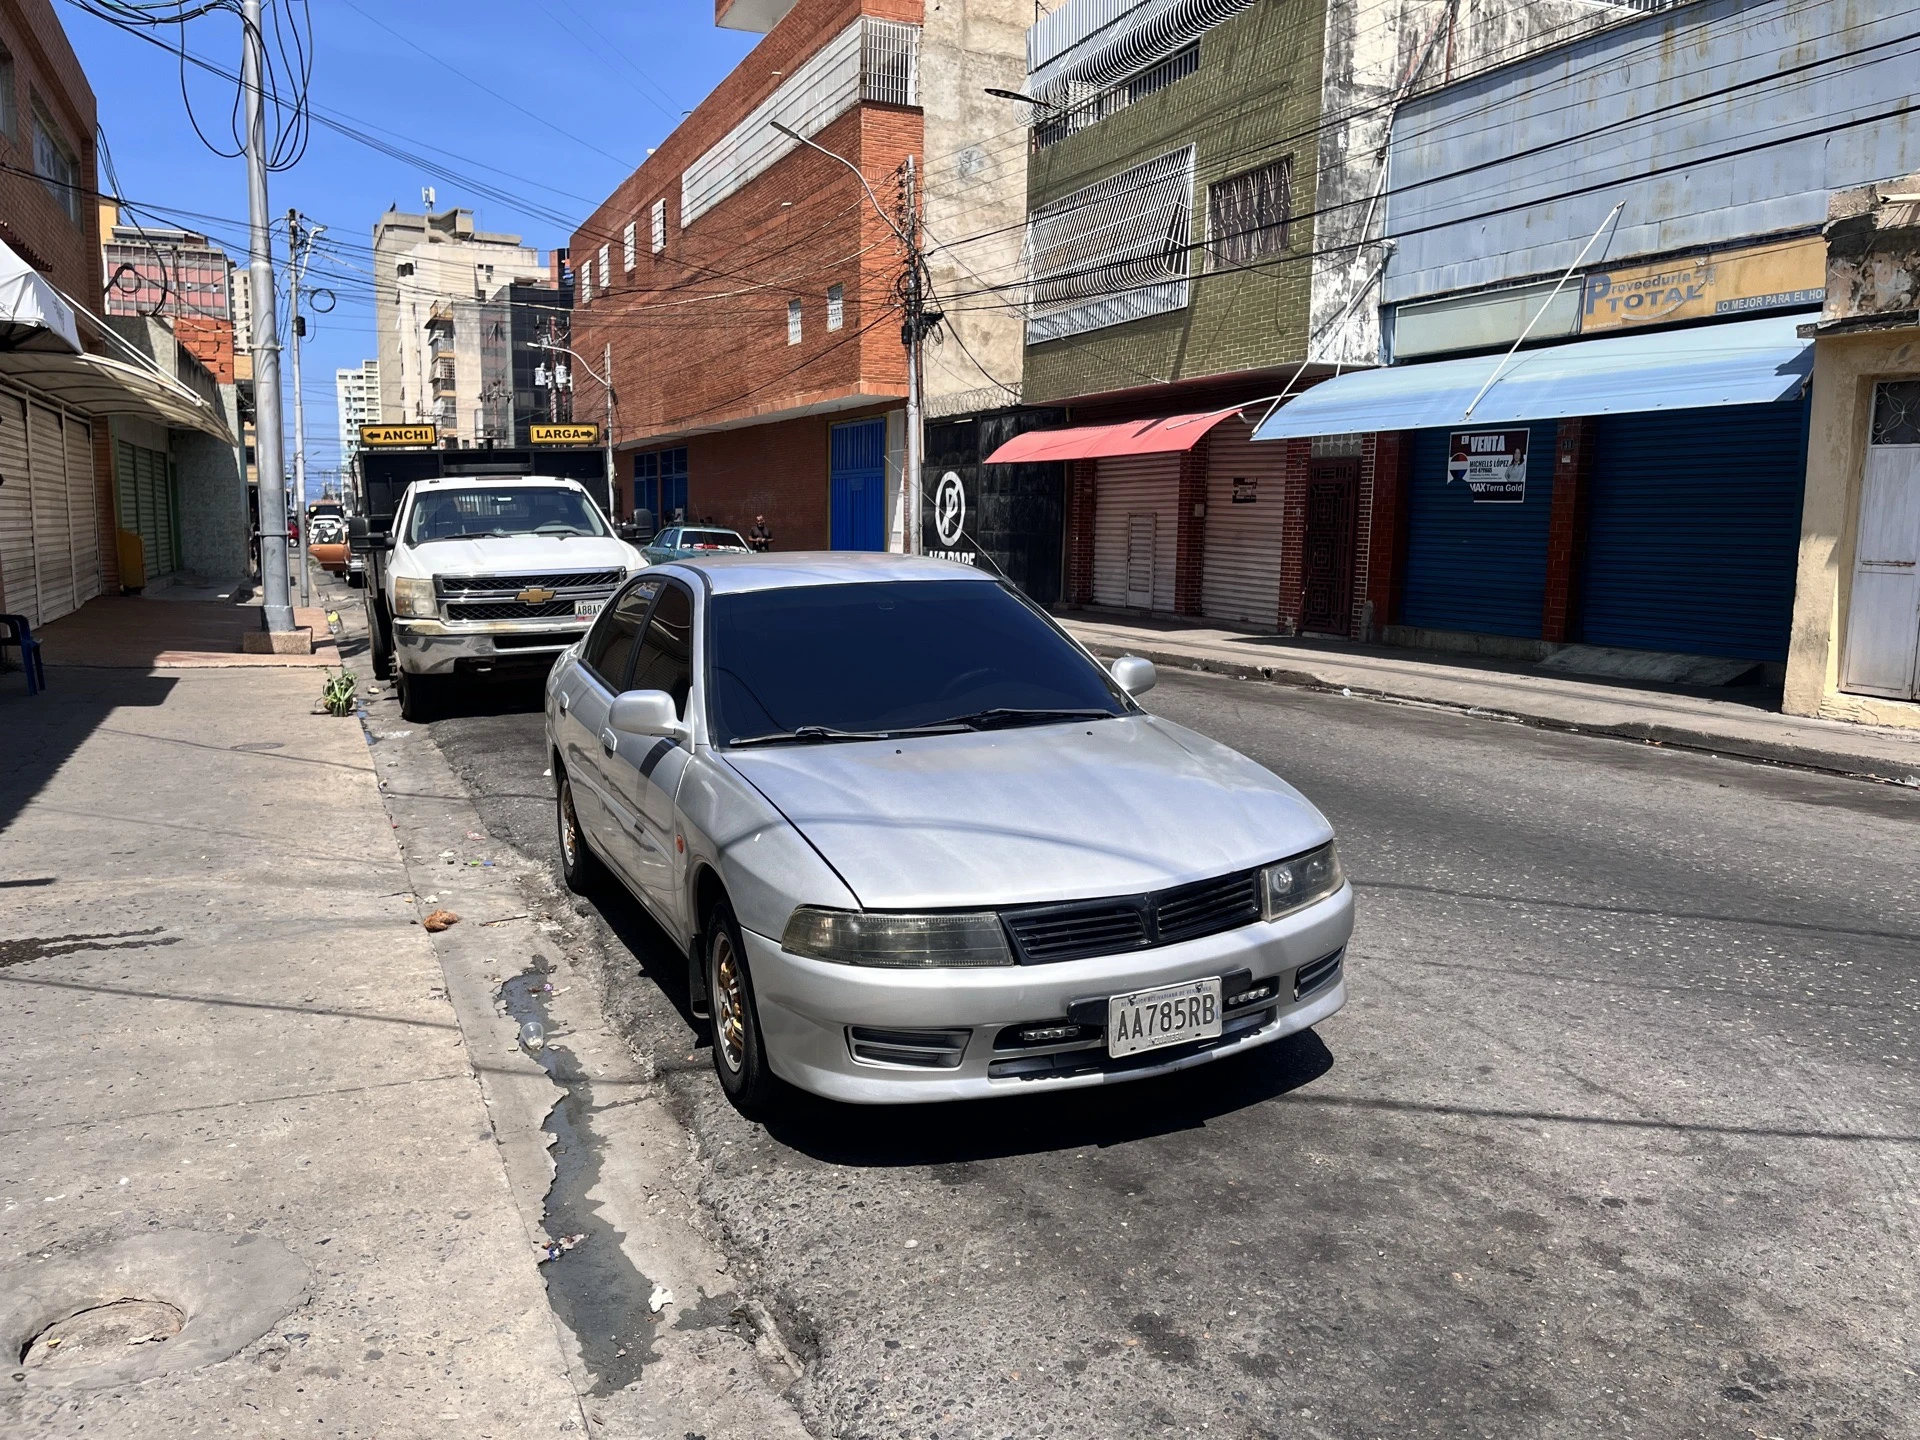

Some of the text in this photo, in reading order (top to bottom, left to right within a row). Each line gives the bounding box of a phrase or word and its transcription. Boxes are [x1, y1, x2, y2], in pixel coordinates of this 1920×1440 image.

[1605, 284, 1704, 313] TOTAL
[1717, 301, 1728, 312] LO
[1731, 297, 1763, 311] MEJOR
[1765, 293, 1791, 306] PARA
[1794, 291, 1806, 302] EL
[383, 430, 429, 441] ANCHI
[536, 429, 581, 439] LARGA
[1470, 435, 1505, 452] VENTA
[1486, 484, 1504, 492] Terra
[1505, 483, 1523, 492] Gold
[1117, 993, 1215, 1042] AA785RB
